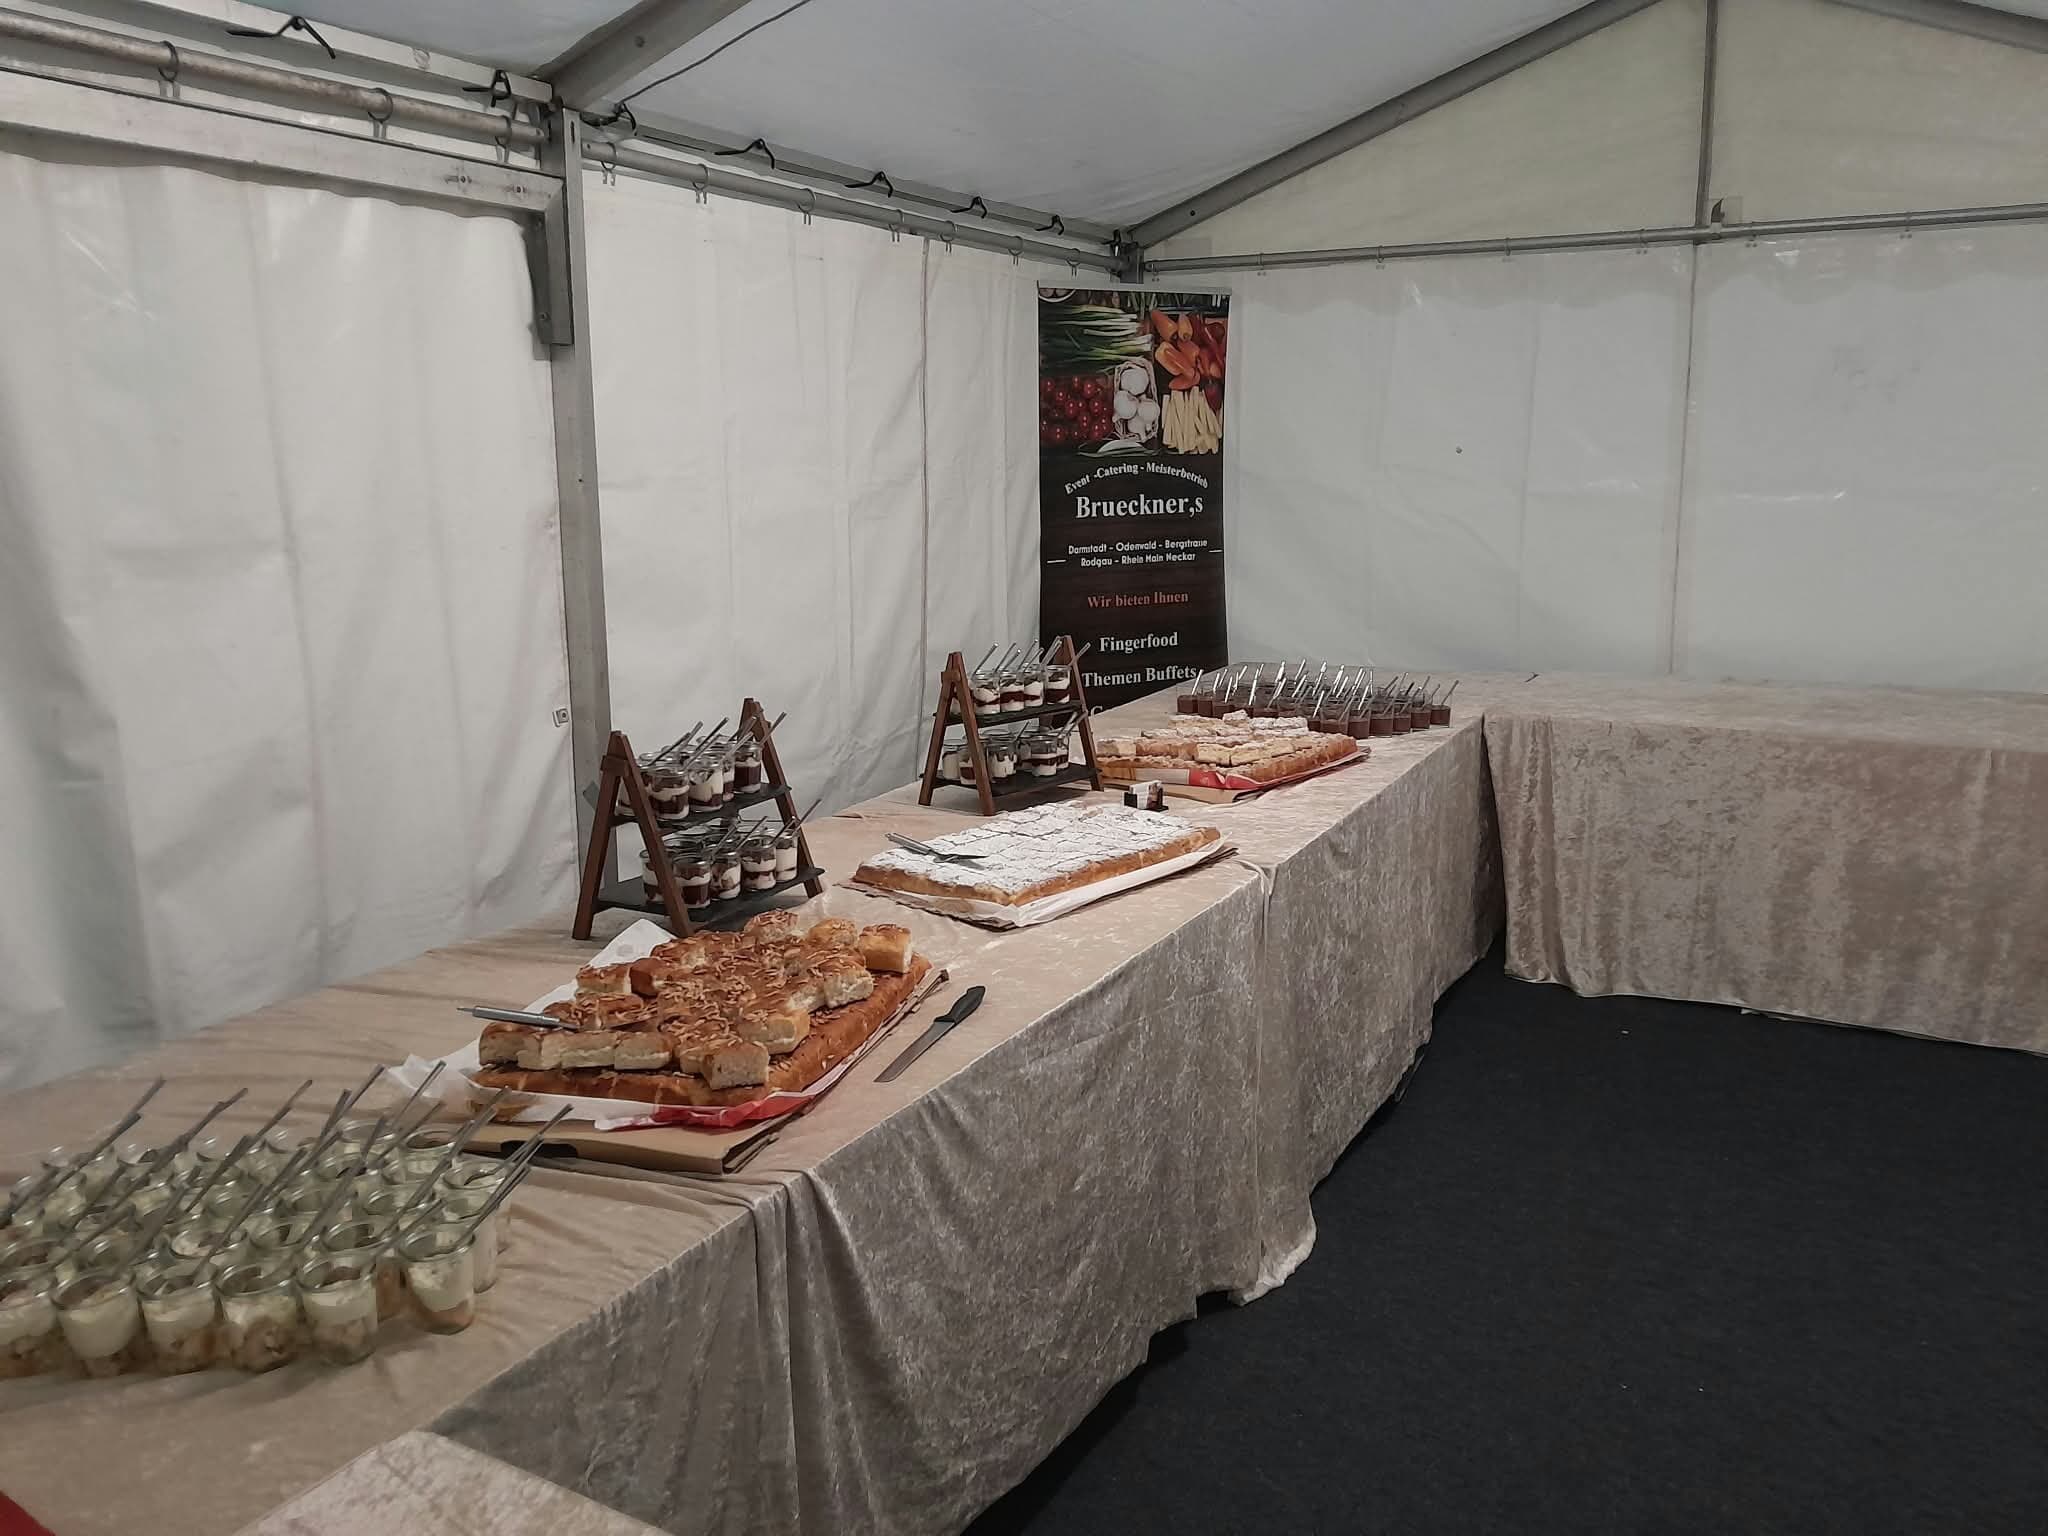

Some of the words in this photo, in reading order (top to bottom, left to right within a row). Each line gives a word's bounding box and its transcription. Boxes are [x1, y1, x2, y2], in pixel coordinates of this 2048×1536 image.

[1065, 474, 1090, 494] Event
[1146, 462, 1208, 488] Meisterbetrieb
[1076, 494, 1203, 518] Brueckner,s
[1068, 543, 1107, 554] Darmstadt
[1115, 541, 1157, 552] Odenwald
[1081, 557, 1113, 568] Rodgau
[1121, 554, 1144, 565] Rhein
[1145, 553, 1164, 563] Main
[1166, 552, 1196, 562] Neckar
[1087, 595, 1113, 608] Wir
[1115, 594, 1151, 607] bieten
[1153, 591, 1189, 604] Ihnen
[1099, 631, 1179, 654] Fingerfood
[1081, 671, 1142, 688] Themen
[1145, 665, 1198, 682] Buffets
